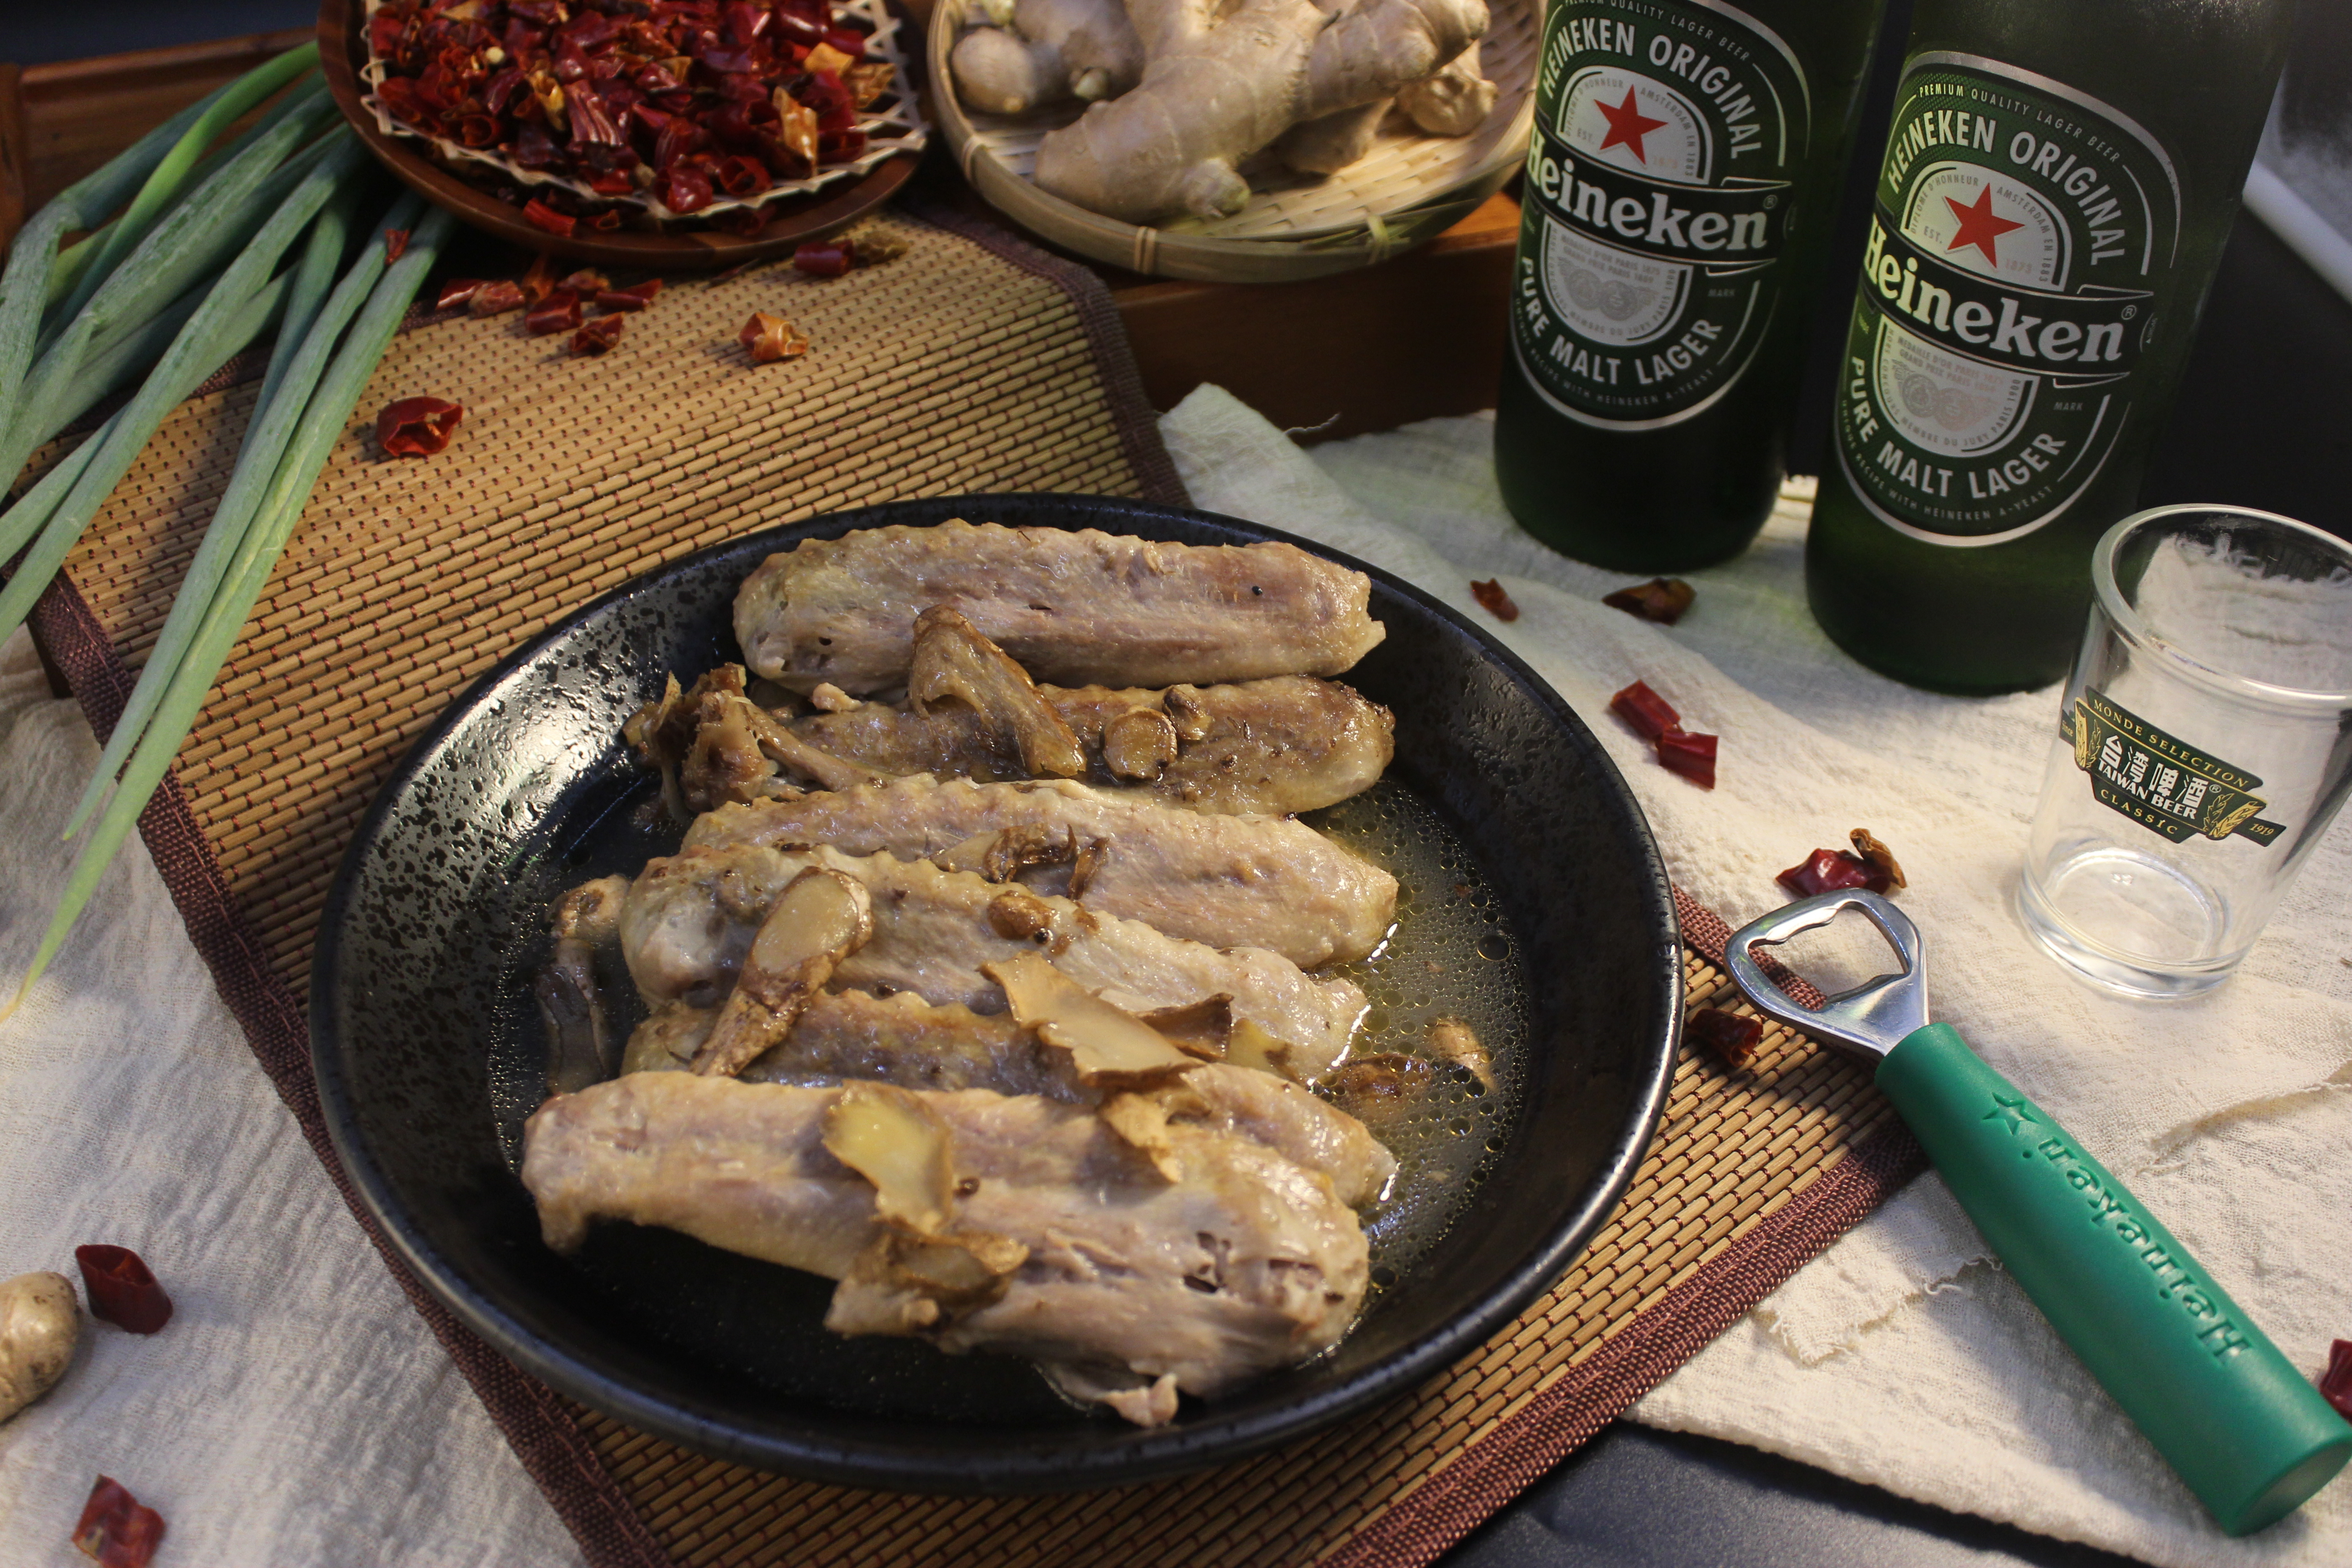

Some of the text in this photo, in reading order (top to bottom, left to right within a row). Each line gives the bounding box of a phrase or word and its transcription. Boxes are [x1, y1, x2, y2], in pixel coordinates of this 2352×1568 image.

[1611, 0, 1750, 61] QUALITY LAGER BEER
[1542, 17, 1761, 159] HEINEKEN ORIGINAL
[1640, 87, 1691, 130] AMSTERDAM
[1919, 83, 2121, 164] PREMIUM QUALITY LAGER BEER
[1526, 122, 1768, 250] Heineken
[1887, 109, 2126, 266] HEINEKEN ORIGINAL
[1910, 190, 1928, 235] DIPLOME
[1923, 225, 1943, 244] EST.
[1997, 186, 2053, 282] AMSTERDAM EN 1883
[1521, 255, 1724, 385] PURE MALT LAGER
[1863, 213, 2125, 362] Heineken
[1597, 394, 1659, 407] HEINEKEN
[1850, 356, 2067, 500] PURE MALT LAGER
[2053, 401, 2083, 412] MARK
[1923, 505, 1991, 521] HEINEKEN
[1999, 485, 2053, 517] A-YEAST
[2094, 699, 2249, 788] MONDE SELECTION
[2098, 757, 2197, 820] TAIWAN BEER
[2100, 789, 2178, 834] CLASSIC
[2249, 823, 2275, 836] 1919
[2038, 1137, 2254, 1365] Heineken
